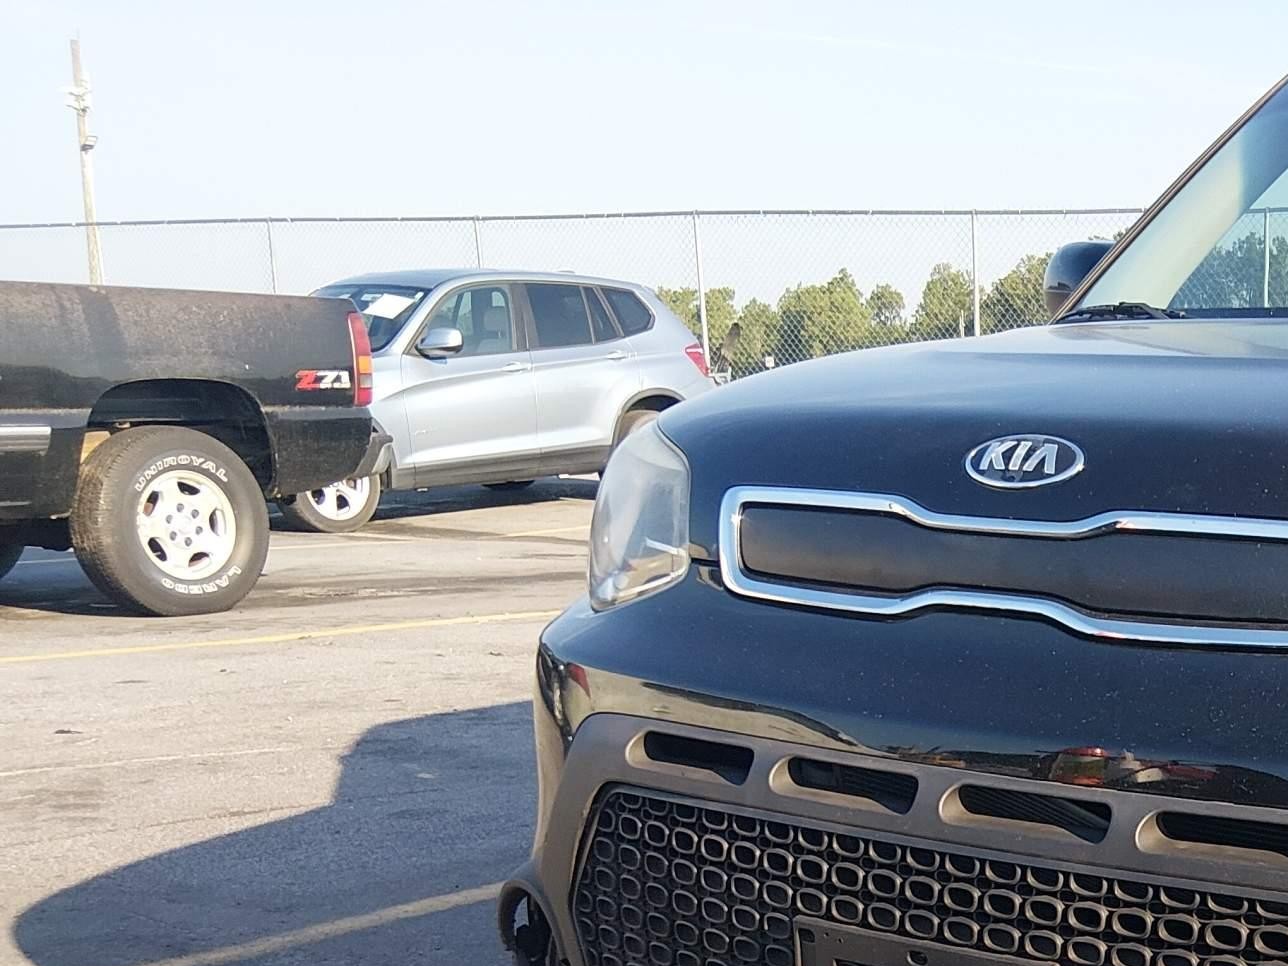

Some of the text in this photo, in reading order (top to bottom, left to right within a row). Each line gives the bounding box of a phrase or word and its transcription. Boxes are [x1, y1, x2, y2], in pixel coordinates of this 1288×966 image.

[295, 369, 352, 391] Z71
[134, 454, 229, 492] UNIROYAL
[978, 440, 1060, 475] KIA
[161, 565, 242, 595] LAREDO
